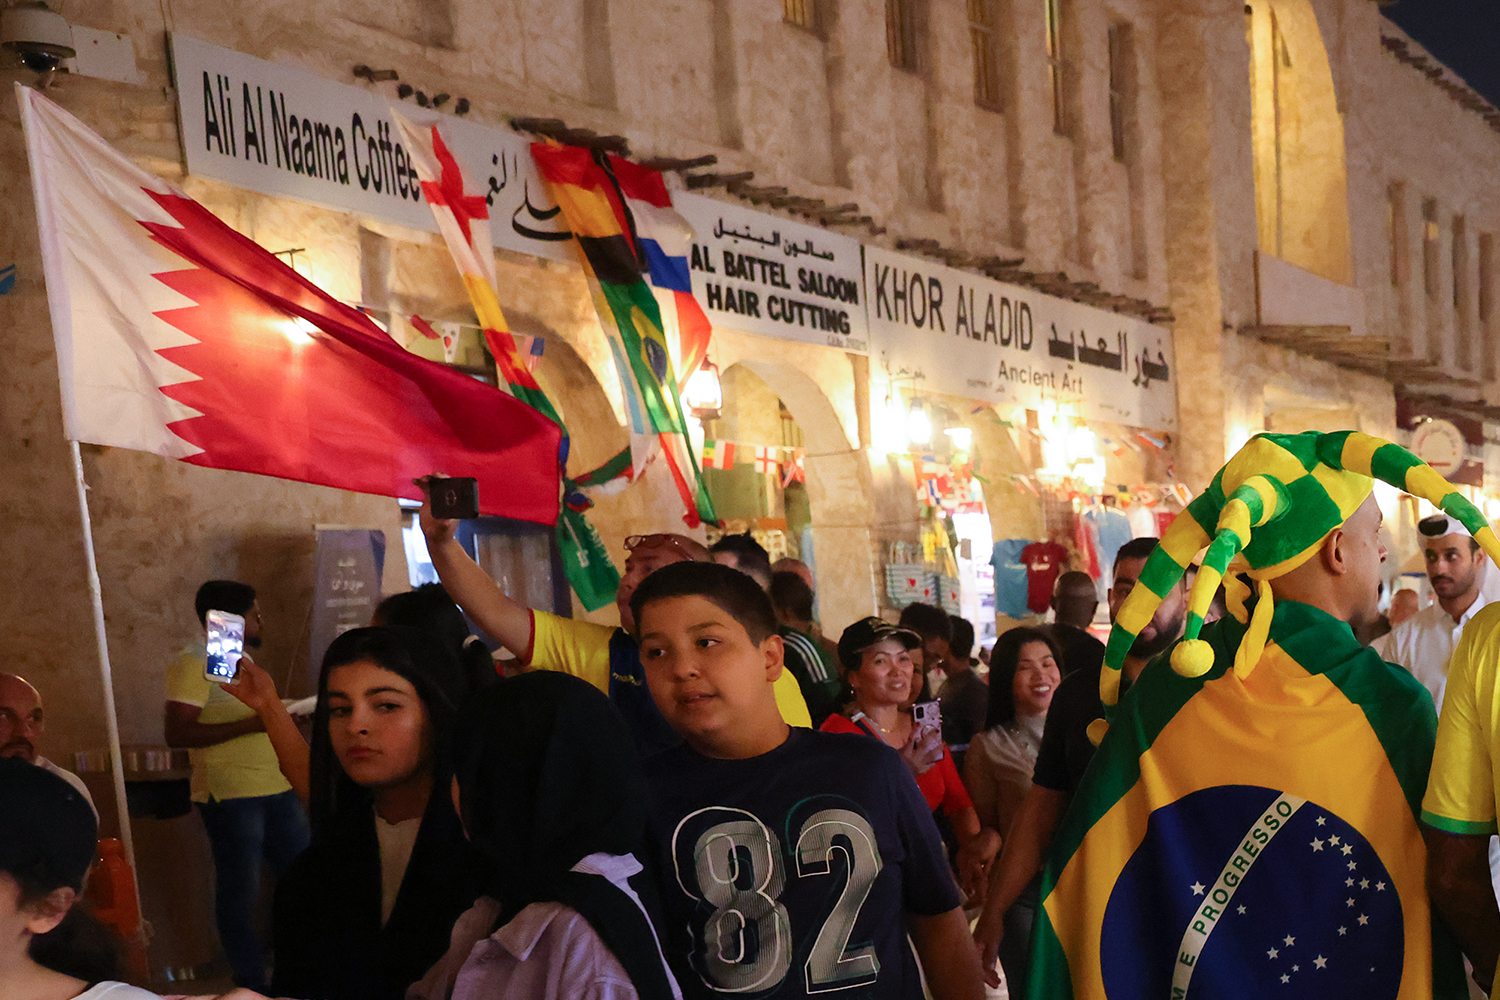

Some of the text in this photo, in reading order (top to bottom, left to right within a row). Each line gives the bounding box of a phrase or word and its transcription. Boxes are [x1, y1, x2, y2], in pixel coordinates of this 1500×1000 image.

[203, 71, 420, 202] Ali Al Naama Coffee
[691, 243, 859, 305] AL BATTEL SALOON
[783, 239, 834, 262] صالون
[706, 282, 851, 335] HAIR CUTTING
[875, 262, 1033, 351] KHOR ALADID
[999, 360, 1055, 389] Ancient
[1062, 372, 1083, 394] Art
[1048, 322, 1169, 389] خور العديد
[672, 794, 883, 1000] 82
[1180, 951, 1196, 968] E
[1192, 800, 1293, 936] PROGRESSO
